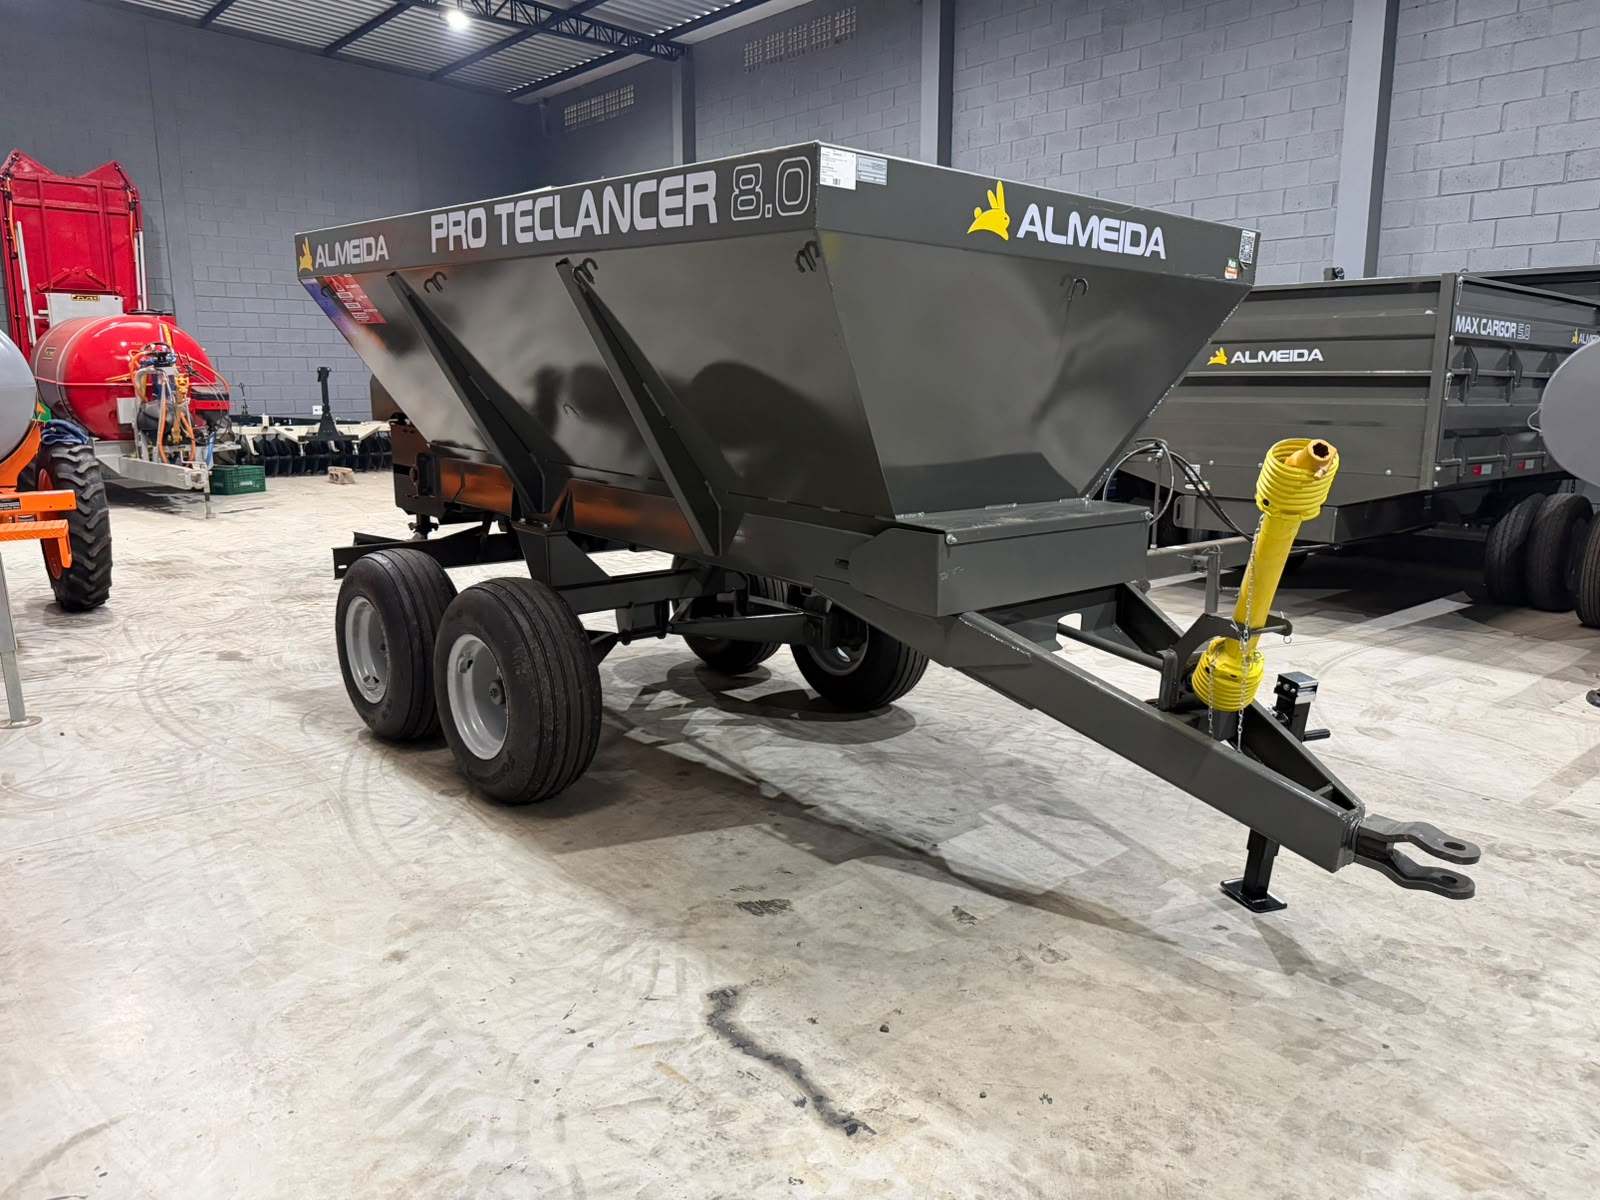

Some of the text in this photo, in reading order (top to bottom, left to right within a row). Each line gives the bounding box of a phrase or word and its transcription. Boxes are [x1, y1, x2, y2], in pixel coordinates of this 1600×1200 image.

[430, 207, 487, 253] PRO
[494, 170, 718, 246] TECLANCER
[731, 156, 812, 222] 8.0
[1016, 203, 1167, 260] ALMEIDA
[315, 234, 390, 269] ALMEIDA
[1455, 314, 1480, 335] MAX
[1480, 318, 1517, 339] CARGOR
[1230, 348, 1324, 364] ALMEIDA
